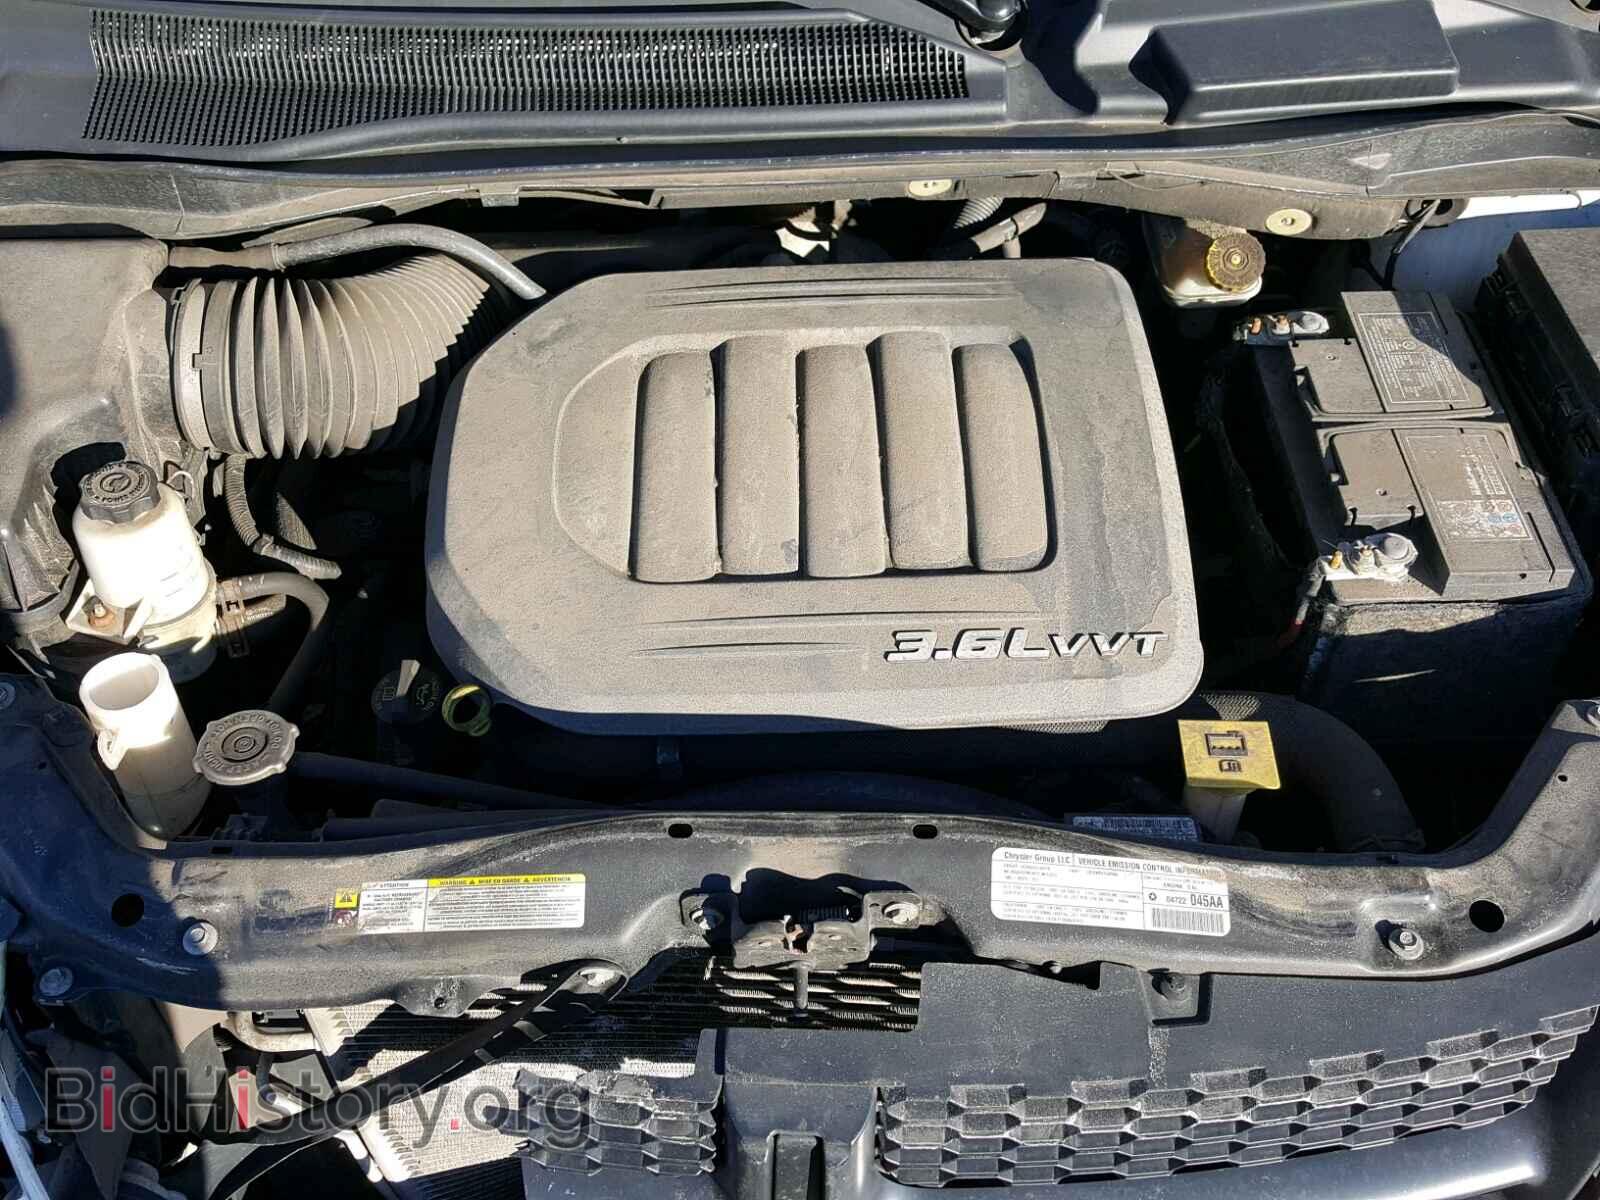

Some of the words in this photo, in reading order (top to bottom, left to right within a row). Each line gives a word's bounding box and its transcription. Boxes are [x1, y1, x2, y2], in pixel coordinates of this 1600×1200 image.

[884, 627, 1050, 661] 3.6L
[1048, 631, 1169, 657] VVT
[1004, 851, 1033, 861] Chrysler
[1034, 853, 1055, 863] Group
[1057, 855, 1072, 864] LLC
[1078, 857, 1105, 867] VEHICLE
[1107, 859, 1140, 870] EMISSION
[1142, 863, 1172, 873] CONTROL
[1190, 893, 1224, 908] 045AA
